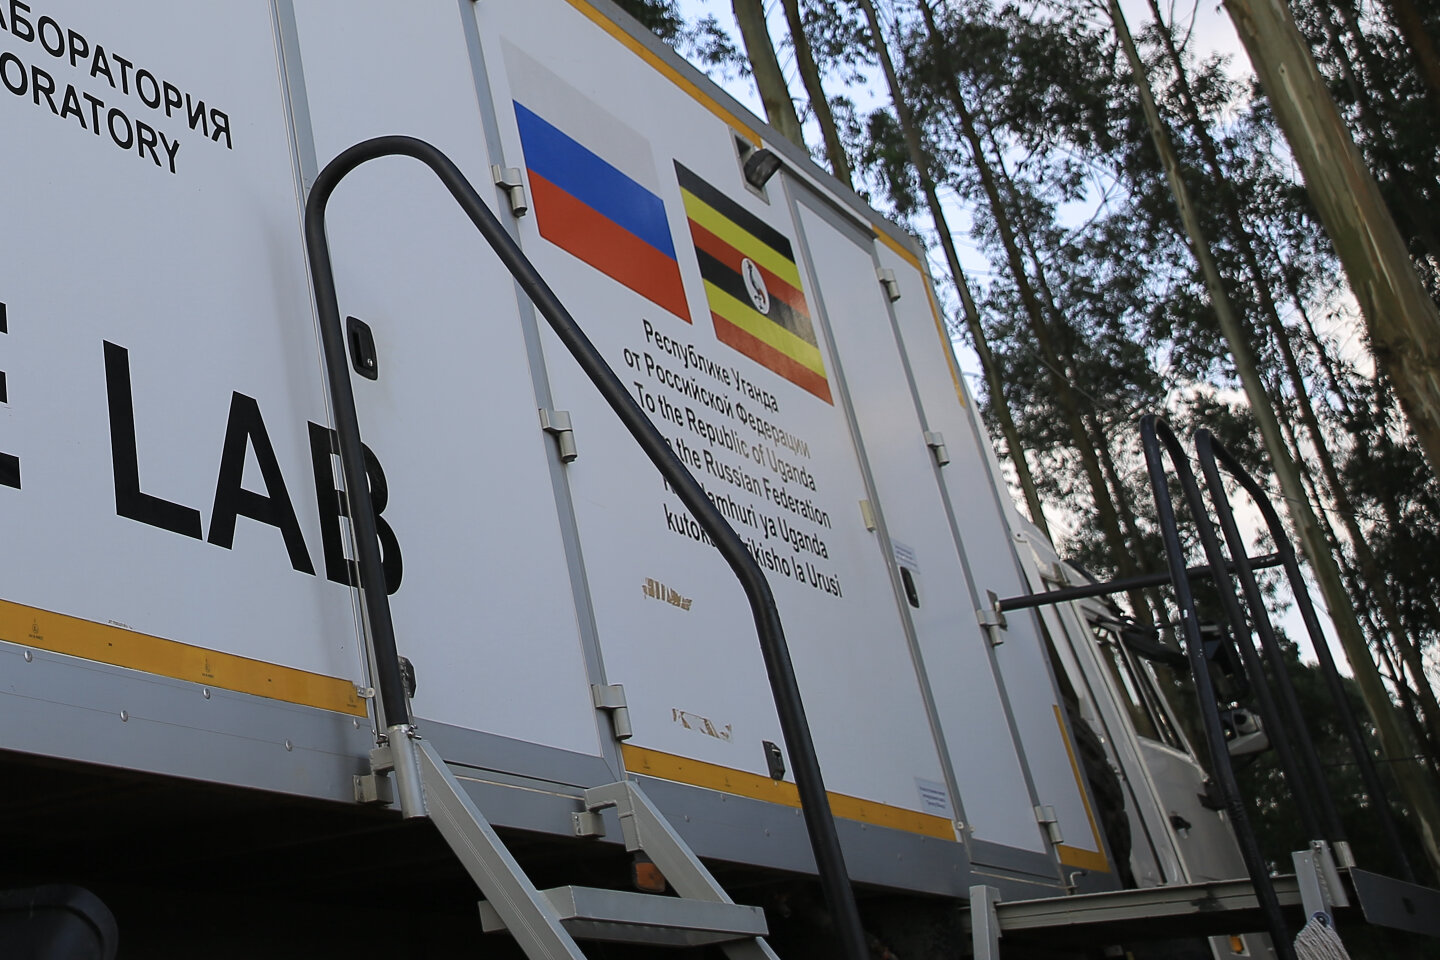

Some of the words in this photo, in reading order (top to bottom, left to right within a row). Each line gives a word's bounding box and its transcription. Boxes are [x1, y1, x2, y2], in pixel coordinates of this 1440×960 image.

[623, 348, 641, 372] от
[643, 351, 735, 420] Российской
[735, 402, 811, 460] Федерации
[642, 318, 731, 387] Республике
[730, 367, 779, 413] Уганда
[102, 339, 403, 596] LAB
[633, 381, 656, 414] To
[658, 394, 684, 428] the
[685, 406, 749, 459] Republic
[752, 443, 766, 467] of
[766, 446, 817, 493] Uganda
[676, 437, 702, 470] the
[703, 448, 763, 498] Russian
[762, 476, 832, 530] Federation
[759, 513, 777, 540] ya
[776, 515, 829, 560] Uganda
[790, 555, 806, 584] la
[805, 561, 843, 597] Urusi
